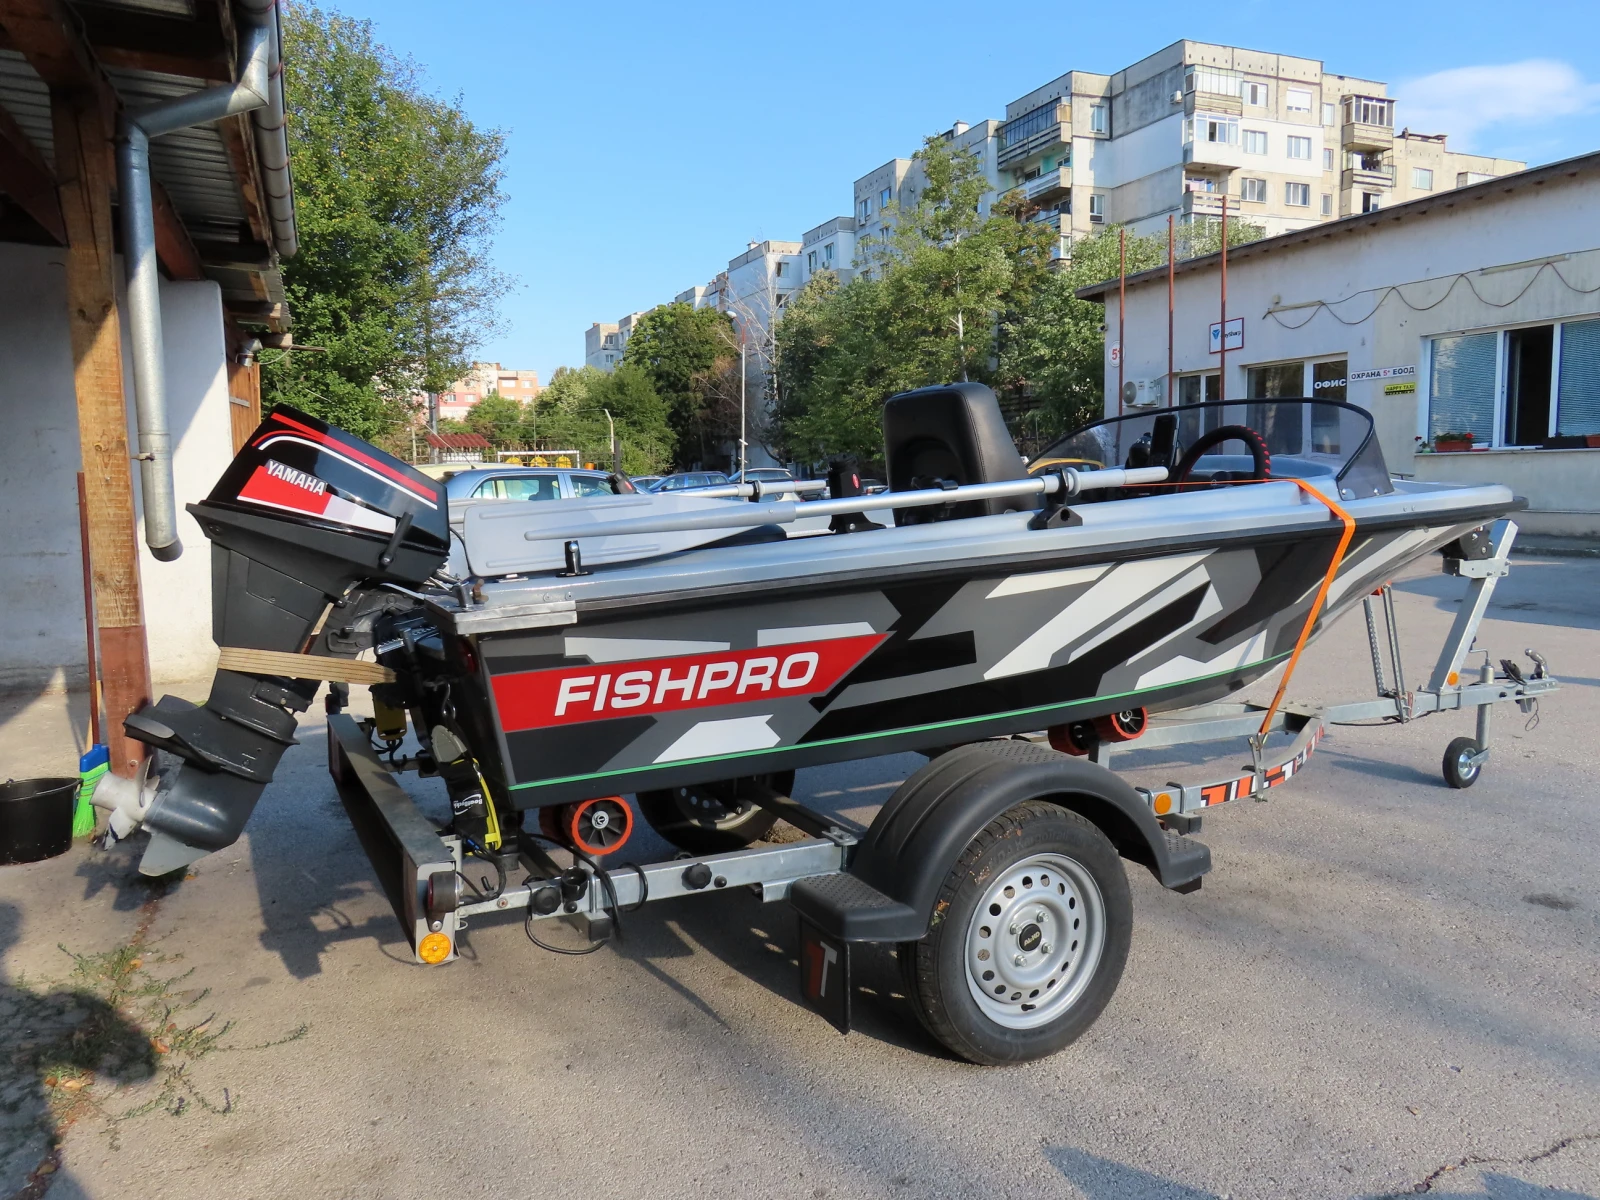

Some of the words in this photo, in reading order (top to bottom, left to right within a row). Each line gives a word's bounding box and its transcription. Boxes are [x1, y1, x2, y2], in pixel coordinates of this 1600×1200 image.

[1314, 378, 1347, 390] ОФИС
[1351, 370, 1381, 380] ОХРАНА
[1393, 366, 1415, 376] ЕООД
[267, 460, 327, 496] YAMAHA
[554, 651, 819, 717] FISHPRO
